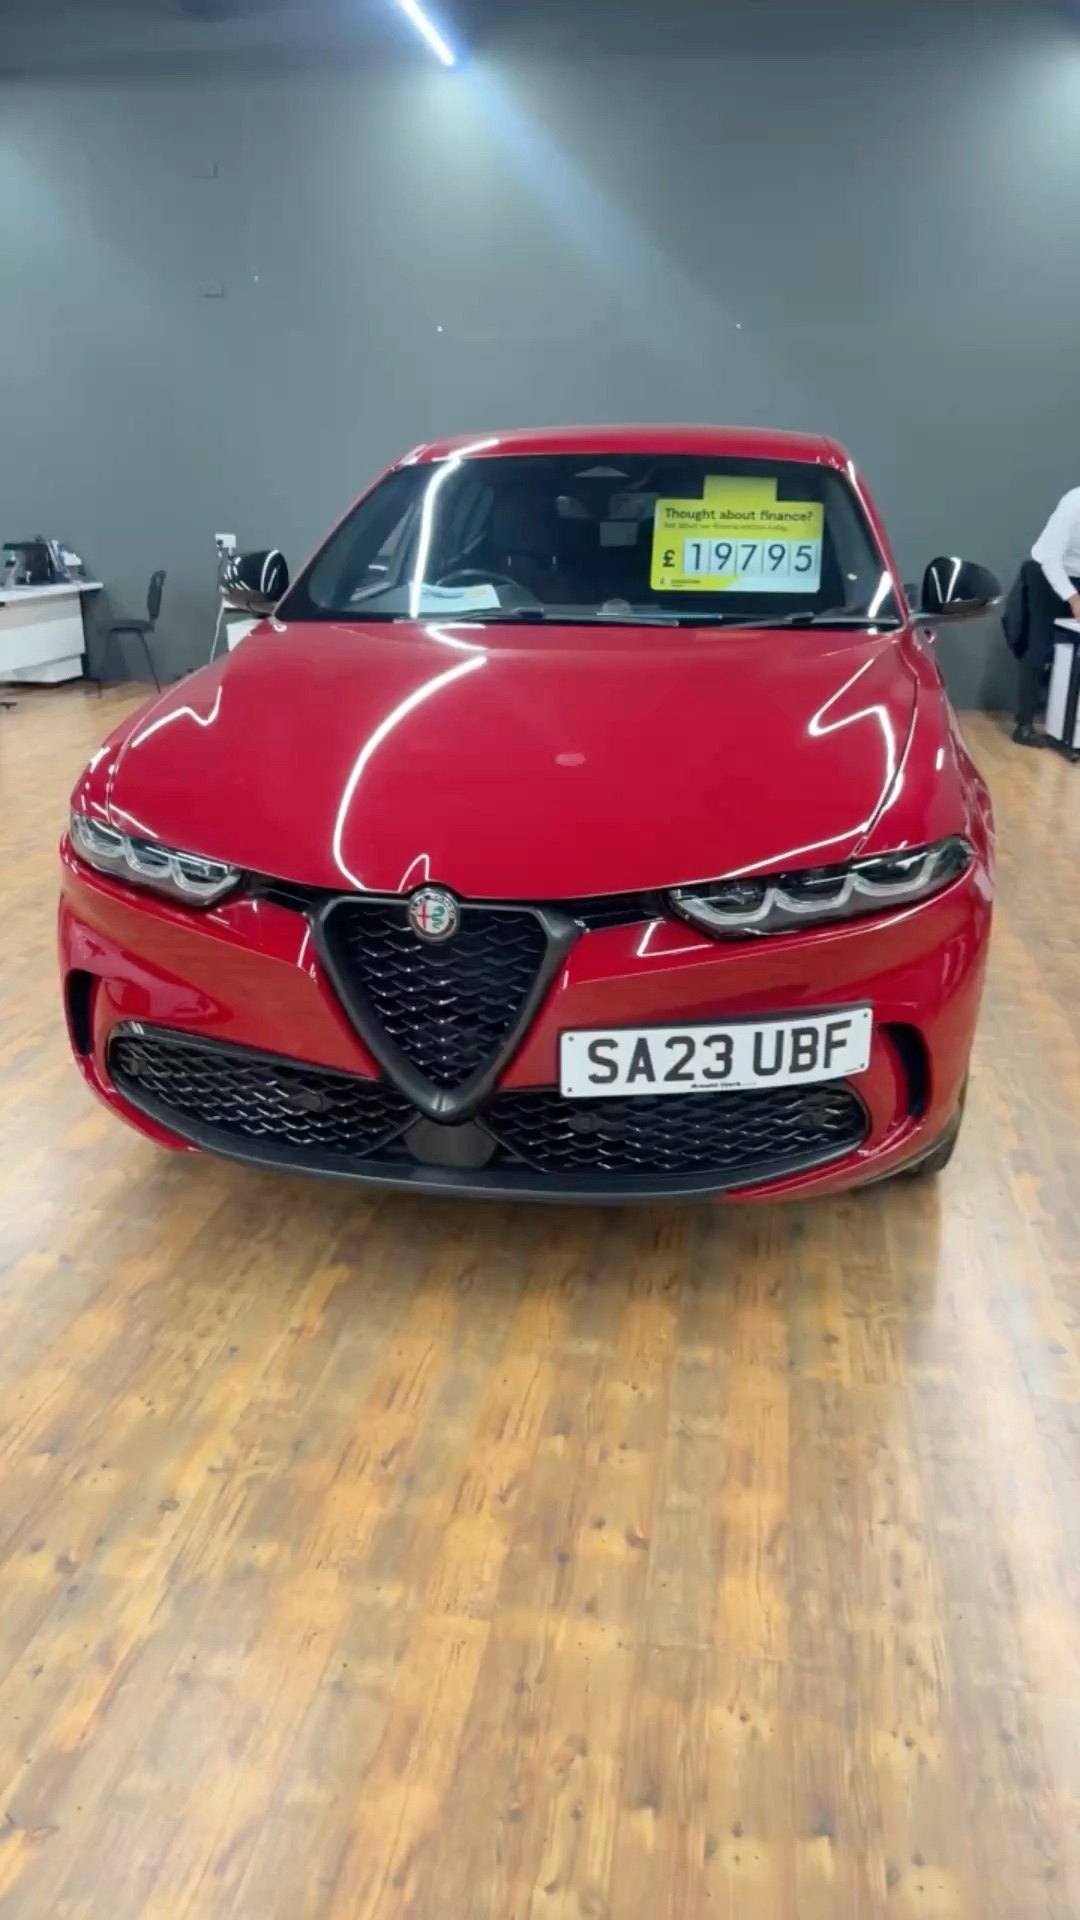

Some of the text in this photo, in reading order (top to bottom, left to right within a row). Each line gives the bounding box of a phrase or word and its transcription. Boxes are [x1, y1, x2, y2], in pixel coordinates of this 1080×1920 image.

[665, 508, 813, 521] Thought about finance?
[662, 542, 813, 572] £ 19795
[587, 1019, 852, 1085] SA23 UBF
